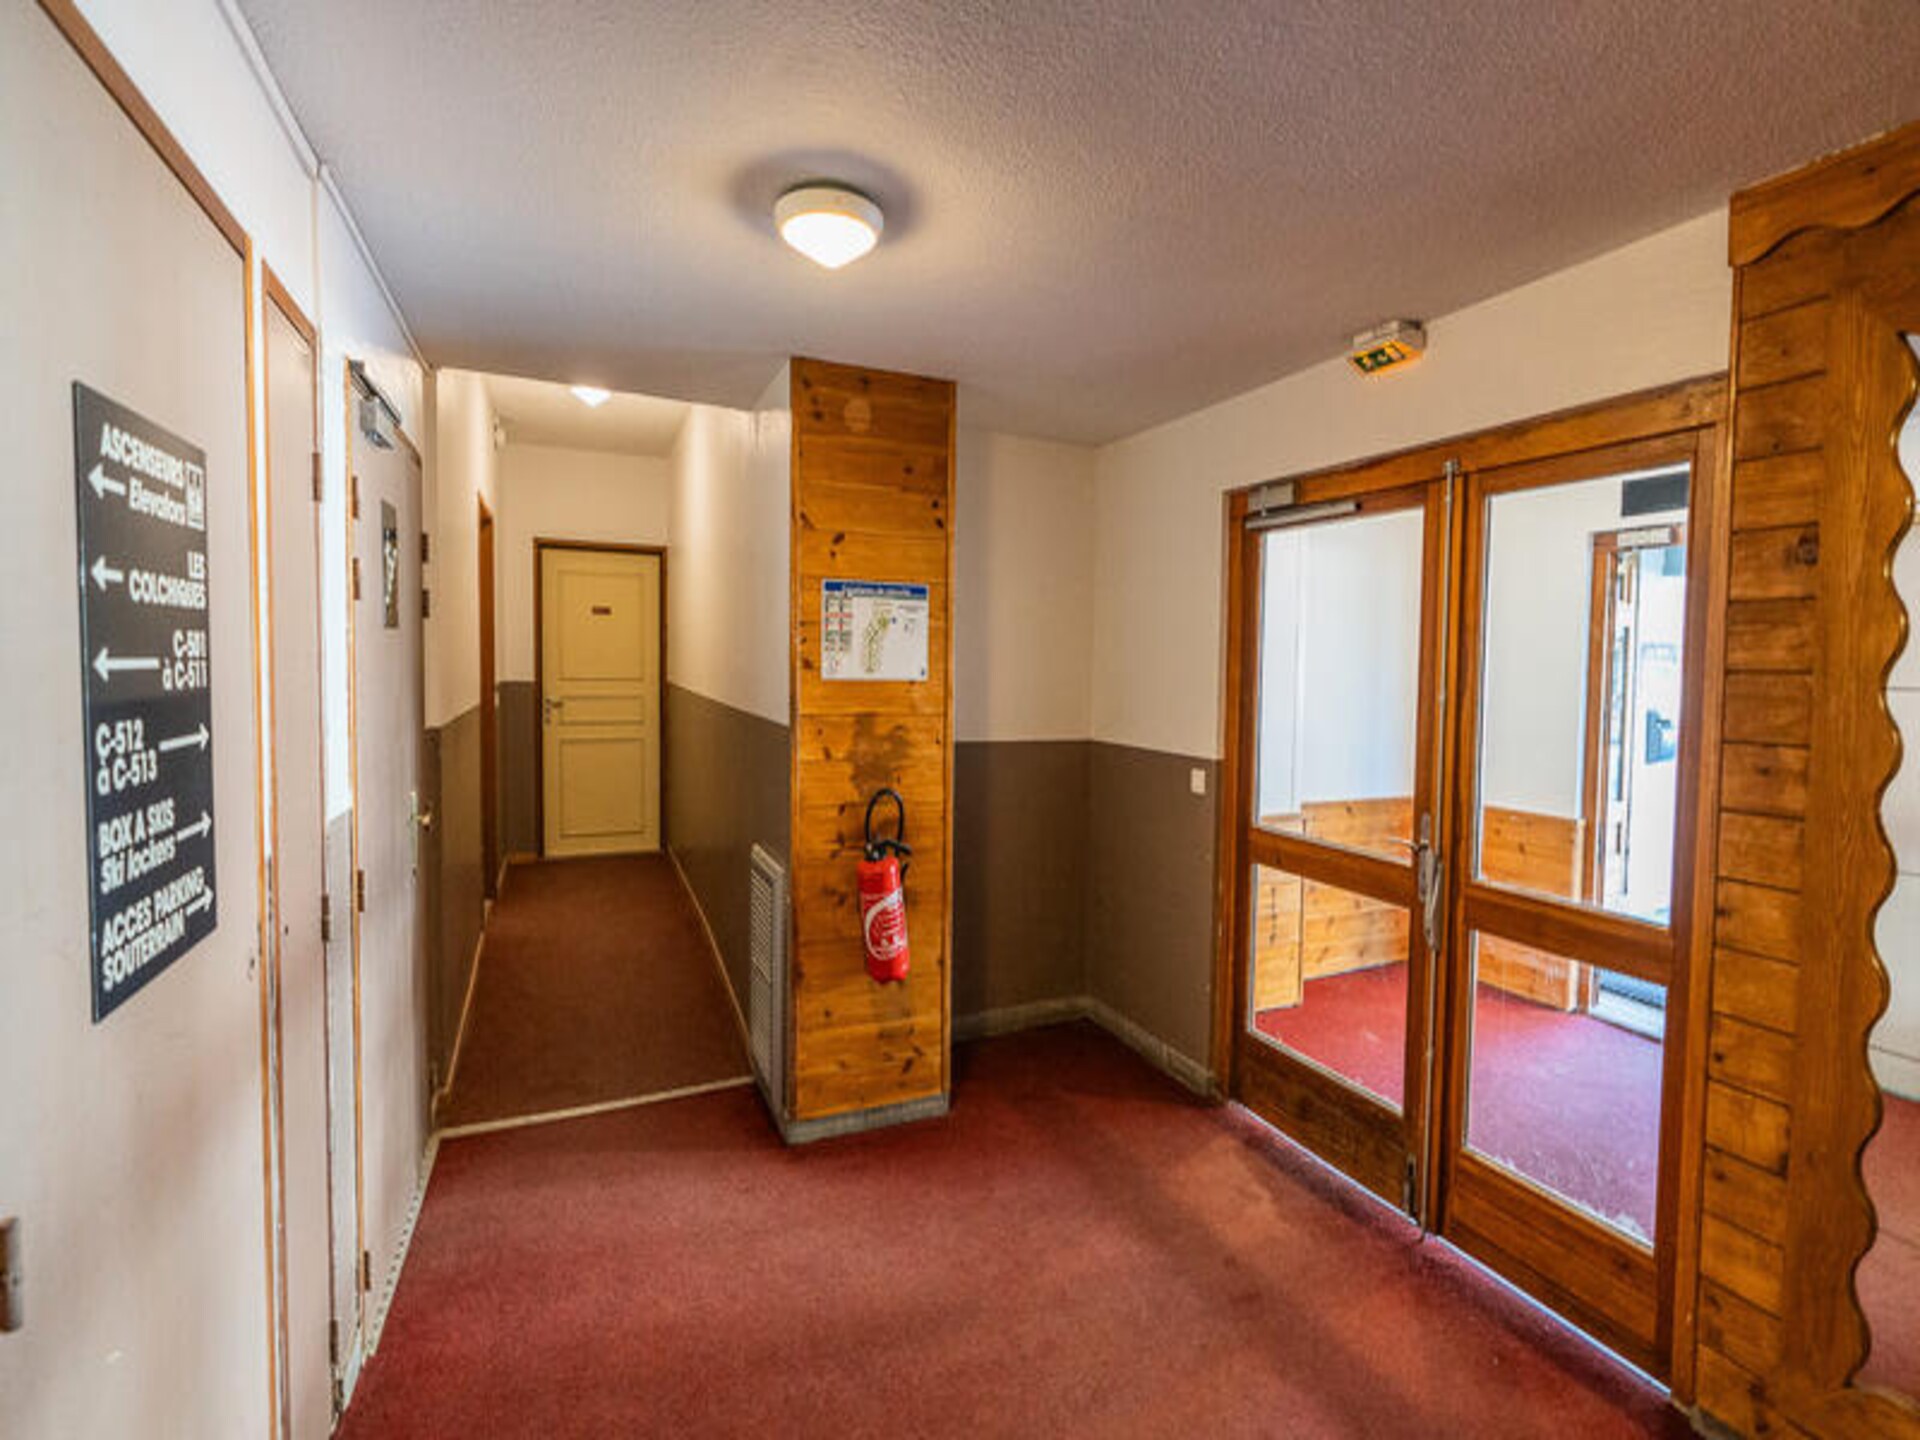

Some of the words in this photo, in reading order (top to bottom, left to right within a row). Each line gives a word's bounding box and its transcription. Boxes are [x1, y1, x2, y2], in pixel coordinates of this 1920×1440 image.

[187, 551, 205, 579] LES
[174, 659, 207, 690] C-511
[95, 718, 144, 758] C-512
[112, 748, 158, 792] C-513
[98, 811, 133, 858] BOX
[134, 808, 147, 845] A
[147, 796, 175, 836] SKIS
[100, 851, 125, 895] Ski
[126, 834, 176, 882] lockers
[100, 896, 152, 957] ACCES
[153, 866, 206, 921] PARKING
[102, 908, 186, 992] SOUTERRAIN
